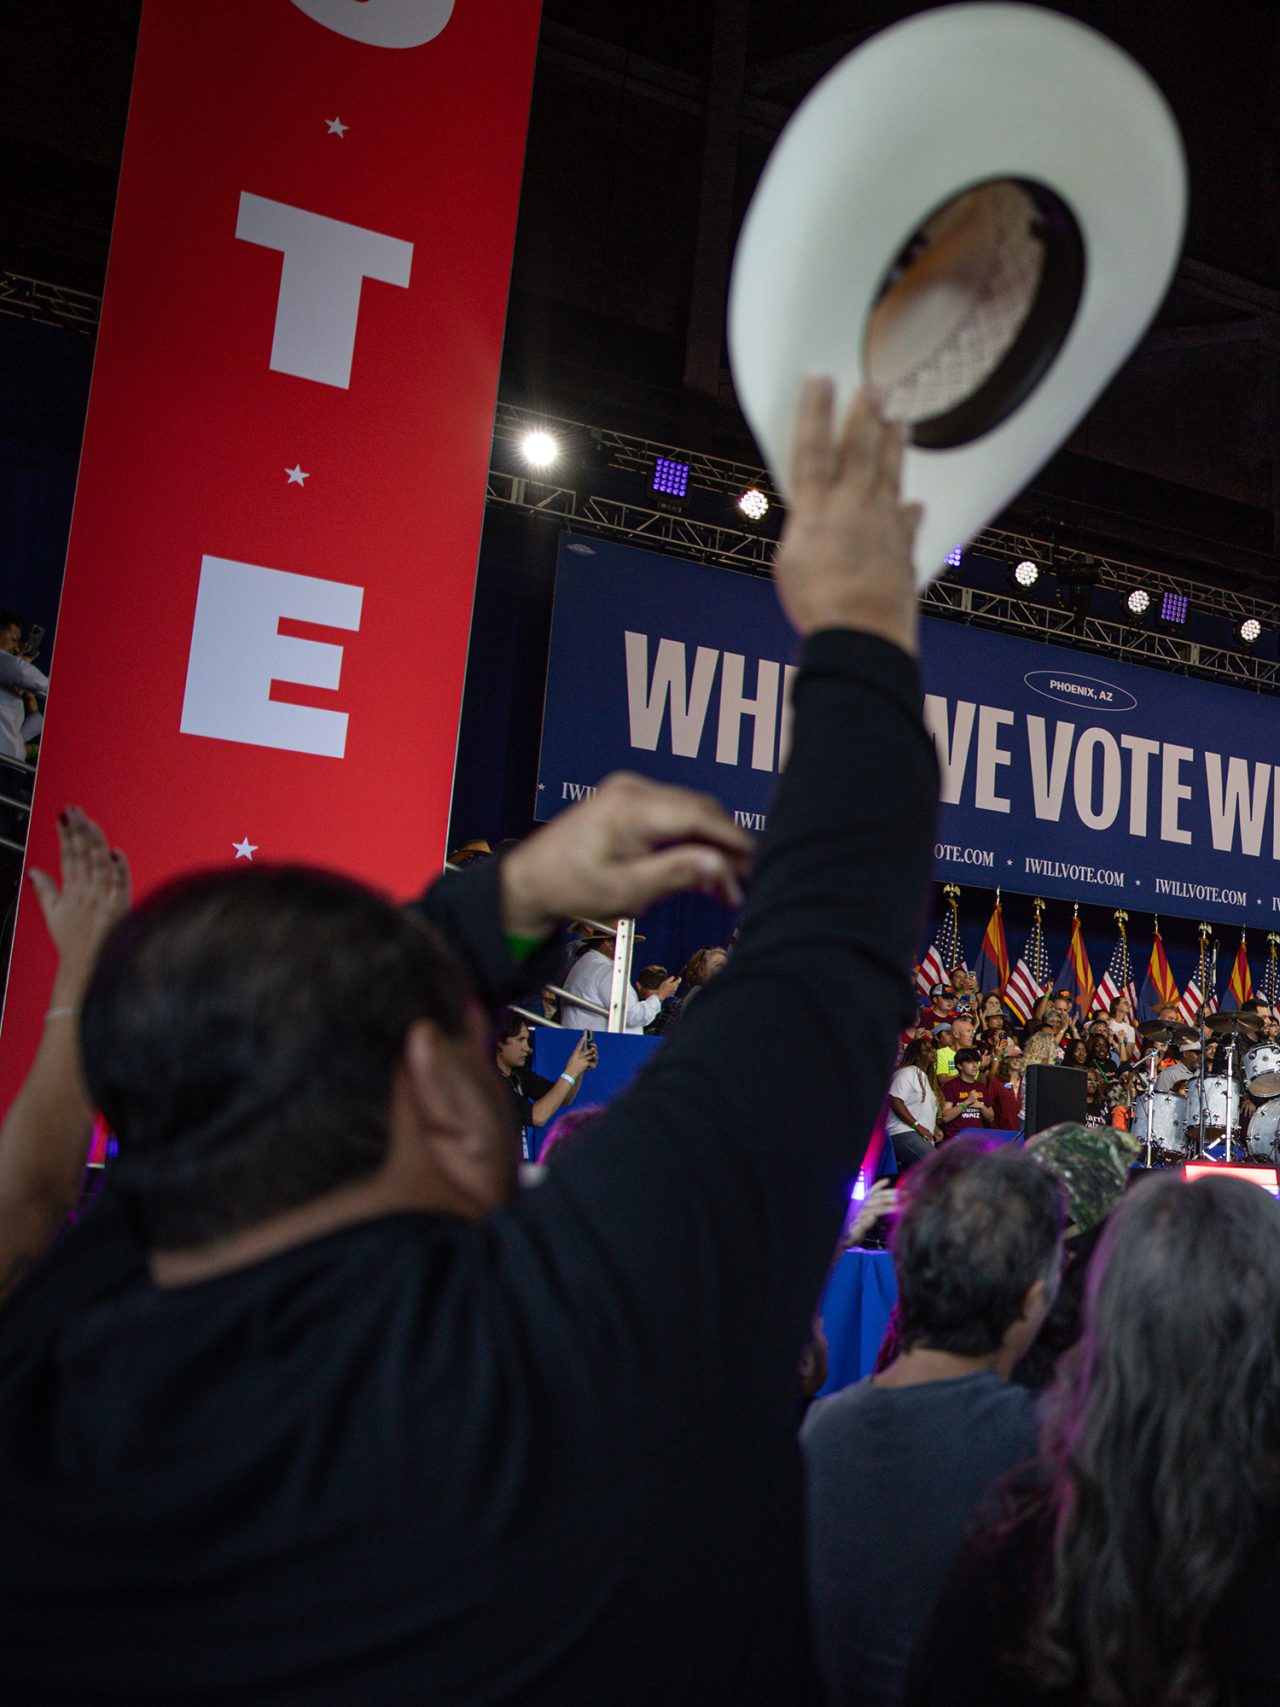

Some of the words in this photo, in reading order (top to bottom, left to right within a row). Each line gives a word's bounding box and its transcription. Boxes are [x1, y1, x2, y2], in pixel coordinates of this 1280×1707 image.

[1049, 679, 1098, 700] PHOENIX,
[1098, 690, 1114, 702] AZ
[1026, 714, 1194, 846] VOTE
[933, 842, 994, 868] OTE.COM
[1024, 857, 1125, 888] IWILLVOTE.COM
[1155, 878, 1247, 906] IWILLVOTE.COM
